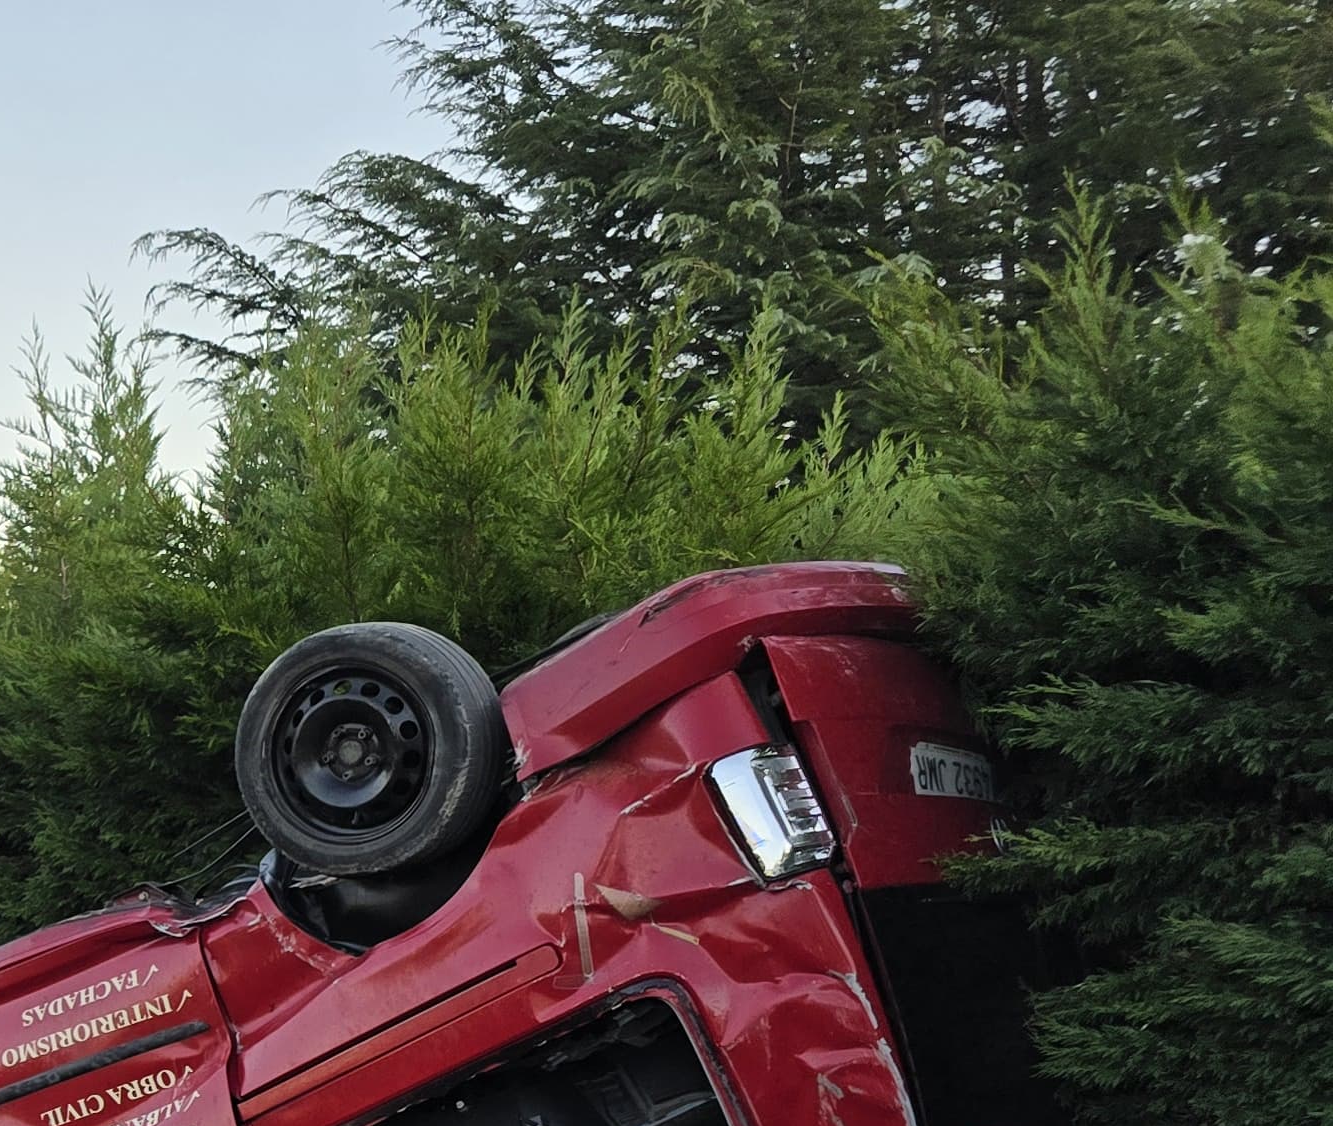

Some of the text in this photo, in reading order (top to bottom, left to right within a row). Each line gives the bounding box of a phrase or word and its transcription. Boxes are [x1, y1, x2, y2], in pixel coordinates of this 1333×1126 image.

[916, 754, 947, 793] JMR
[21, 969, 140, 1028] FACHADAS
[1, 993, 174, 1068] INTERIORISMO
[106, 1069, 177, 1105] OBRA
